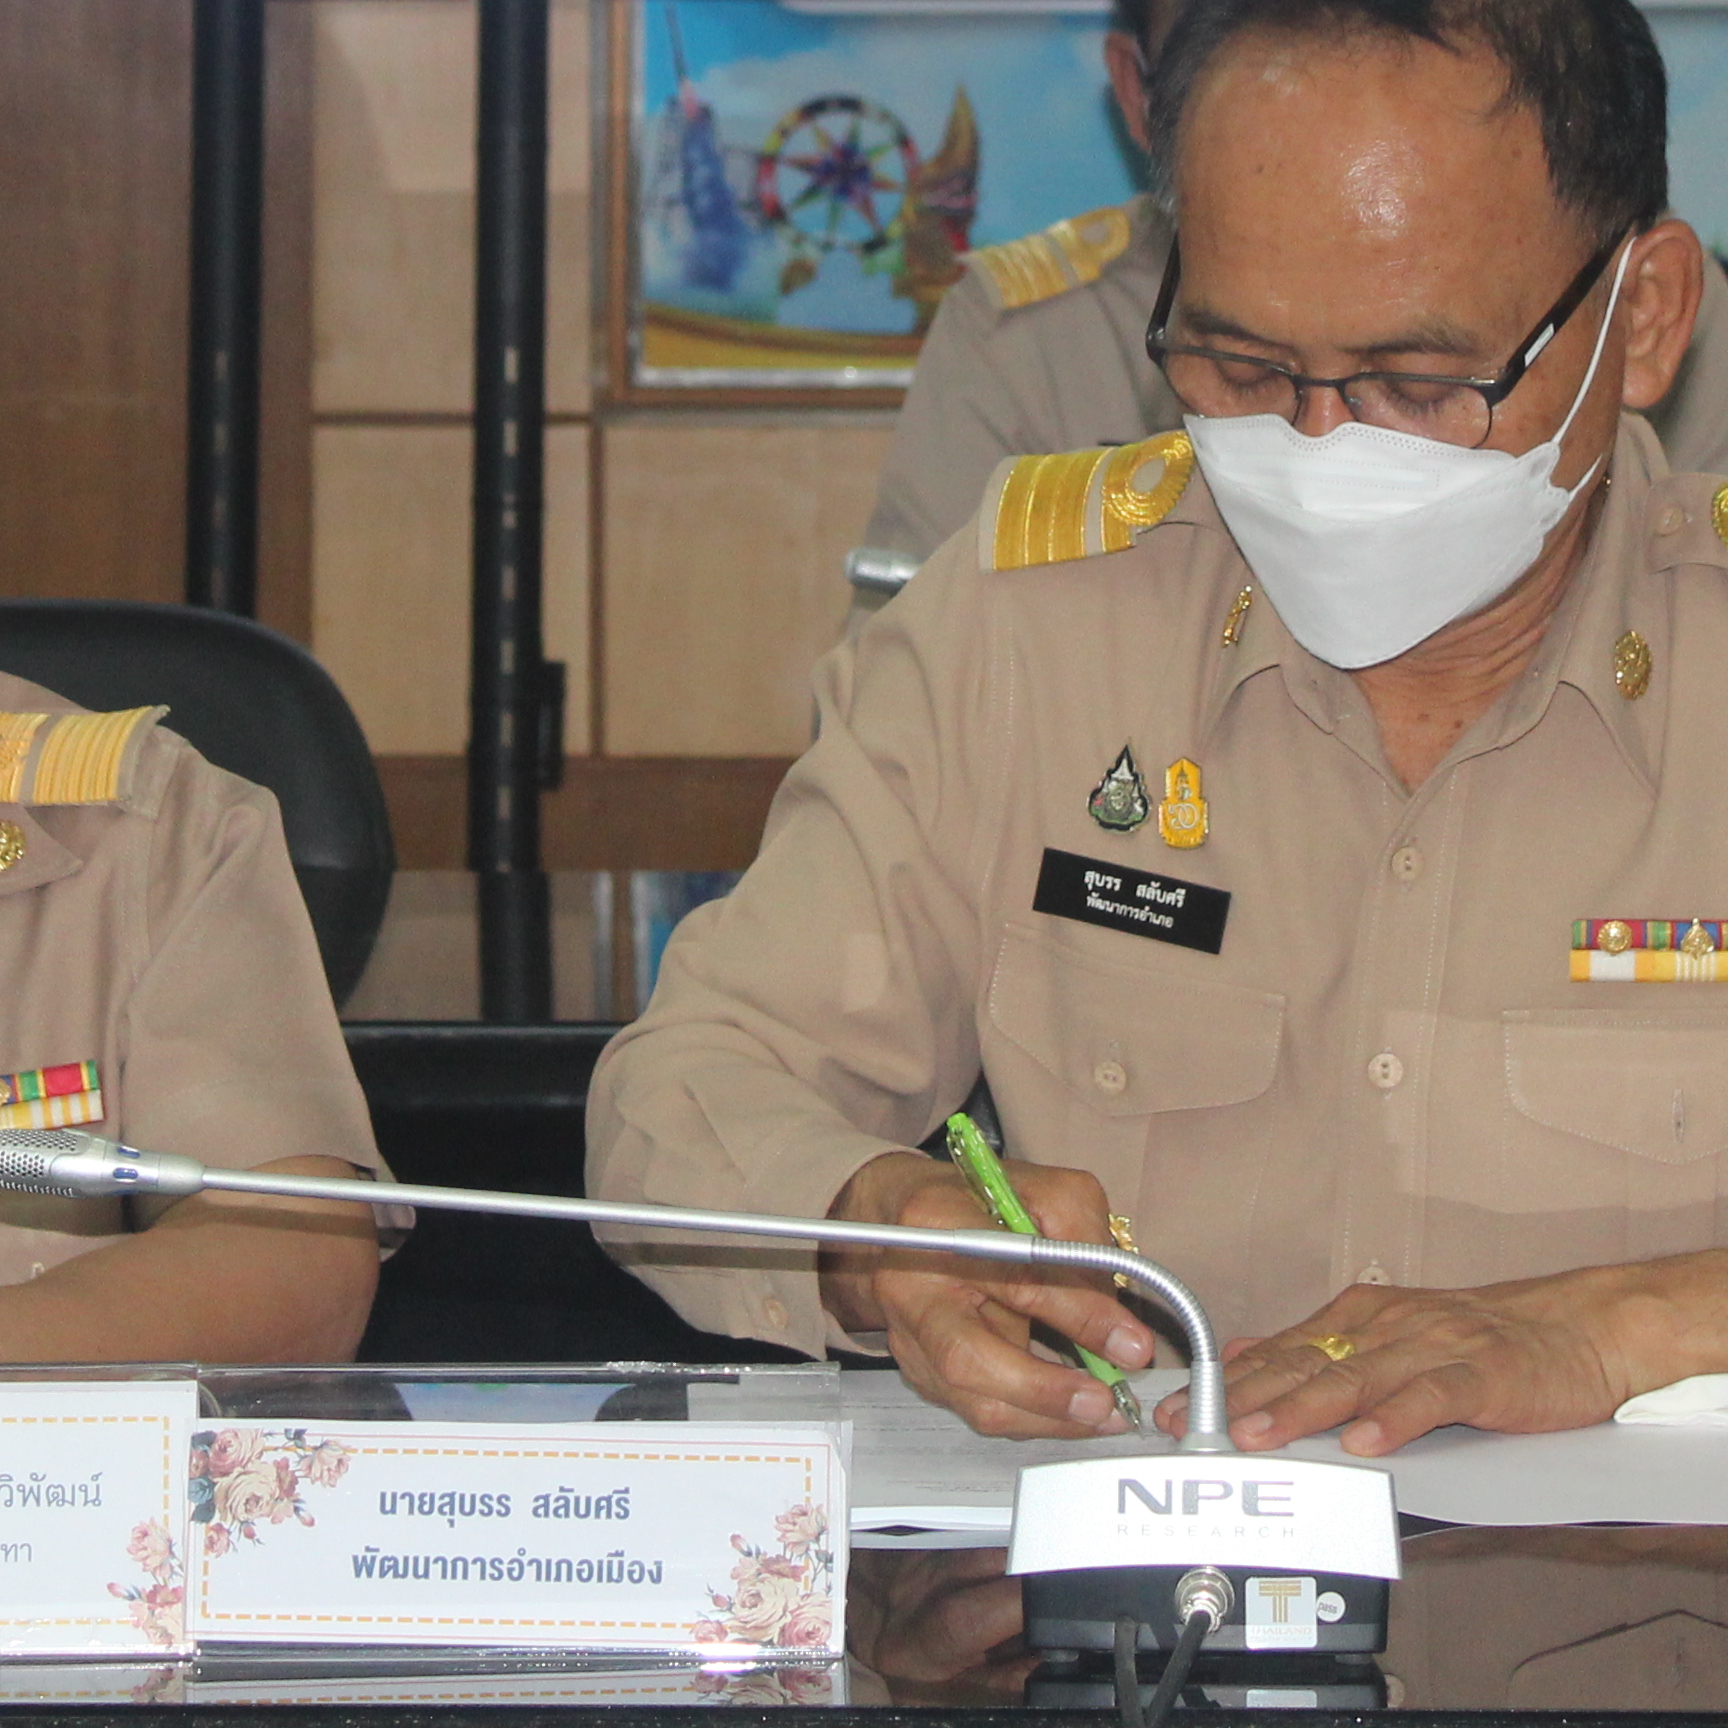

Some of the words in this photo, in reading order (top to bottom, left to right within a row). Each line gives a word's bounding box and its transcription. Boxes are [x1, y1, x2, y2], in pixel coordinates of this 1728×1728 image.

[378, 1487, 512, 1529] นายสุบรร
[531, 1485, 631, 1521] สลับศรี
[1117, 1478, 1295, 1517] NPE
[1117, 1523, 1297, 1539] RESEARCH
[351, 1545, 664, 1586] พัฒนาการอำเภอเมือง
